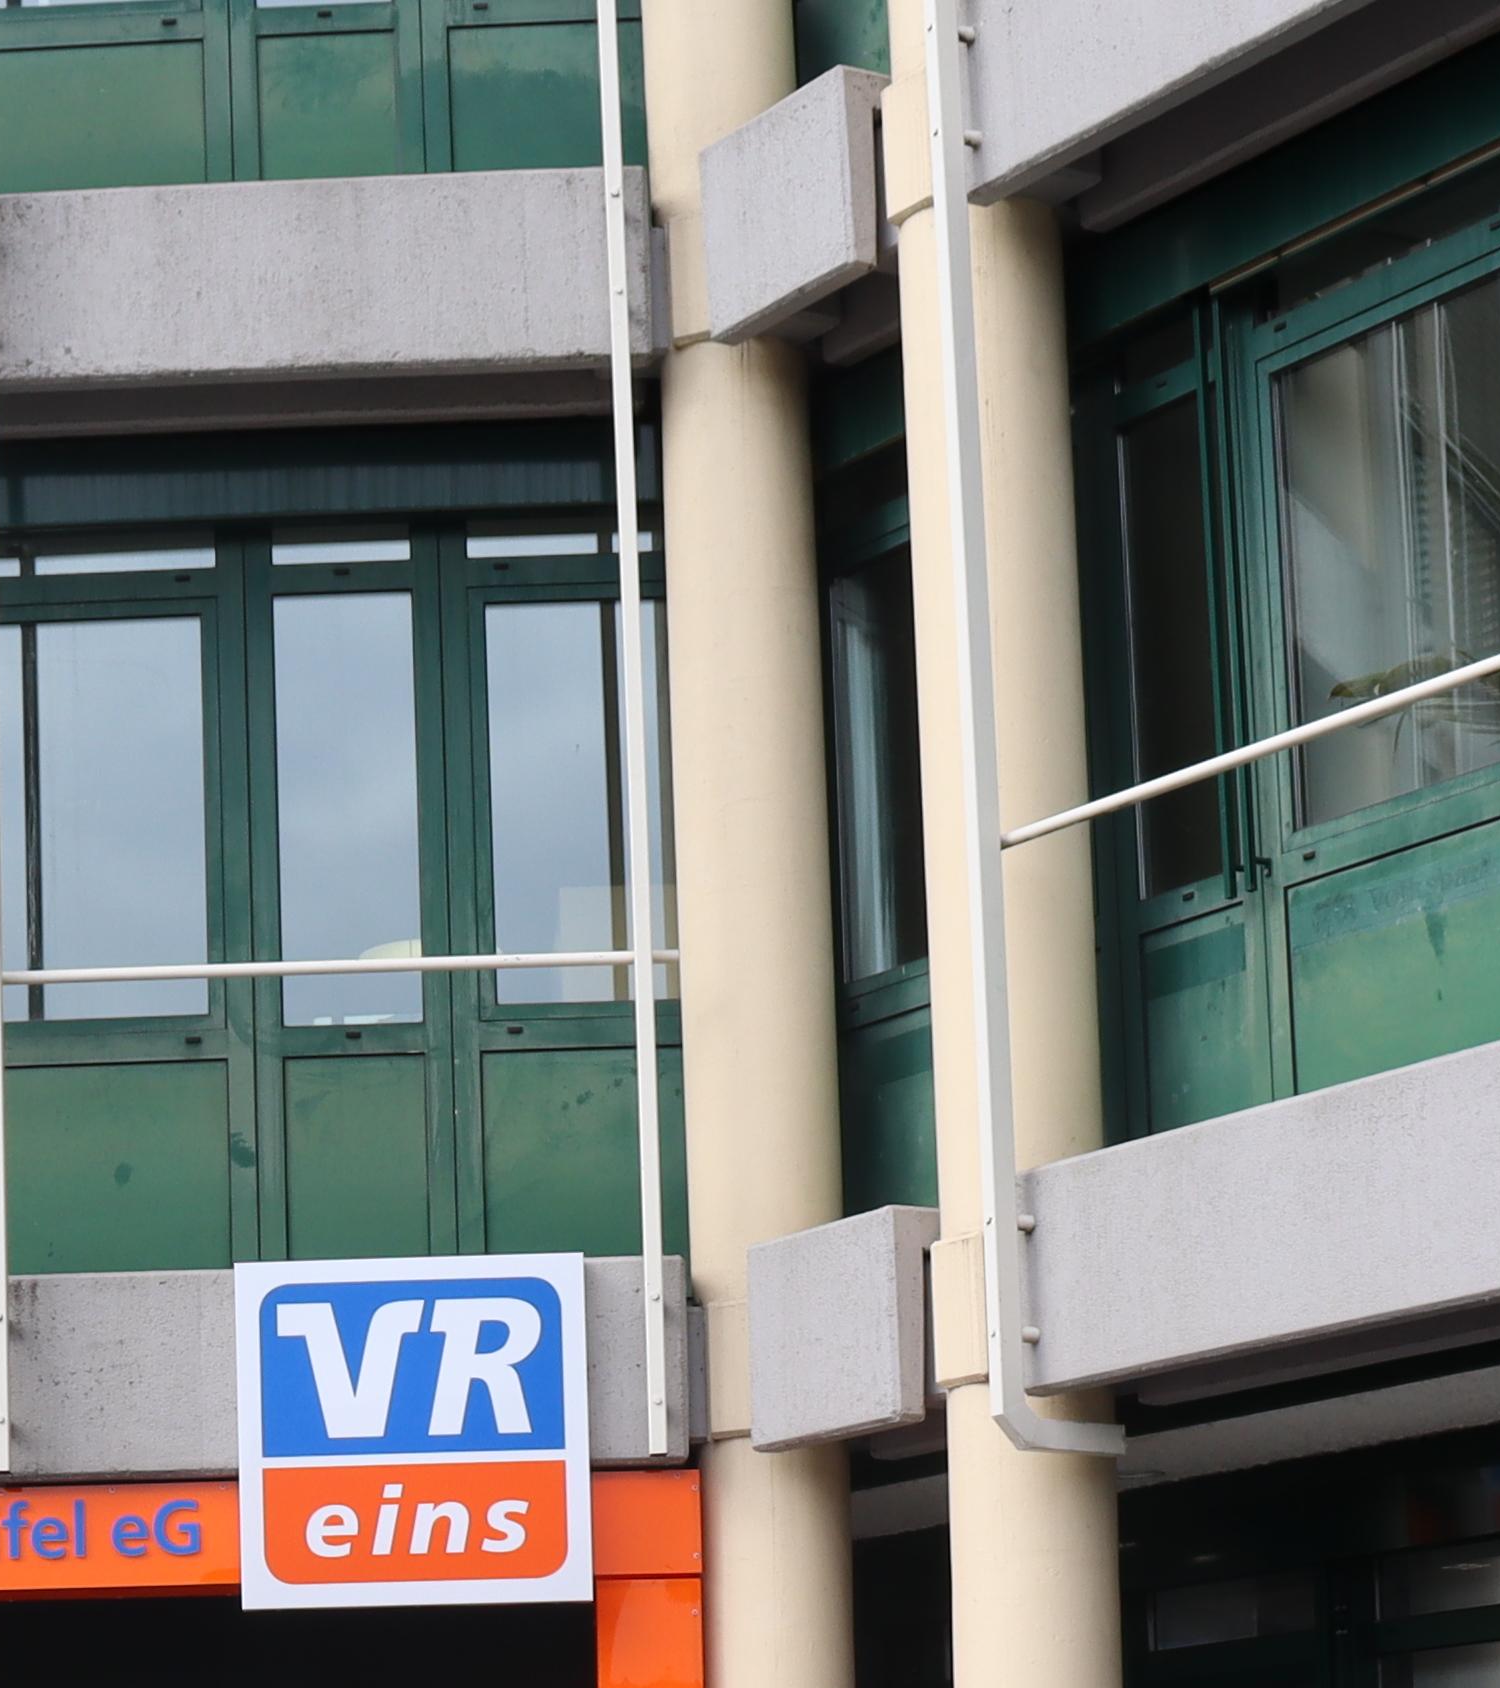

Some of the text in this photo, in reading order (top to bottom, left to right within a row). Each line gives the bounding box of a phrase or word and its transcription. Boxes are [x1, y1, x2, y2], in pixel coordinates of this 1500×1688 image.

[276, 1297, 542, 1439] VR
[110, 1498, 201, 1557] eG
[304, 1482, 530, 1558] eins
